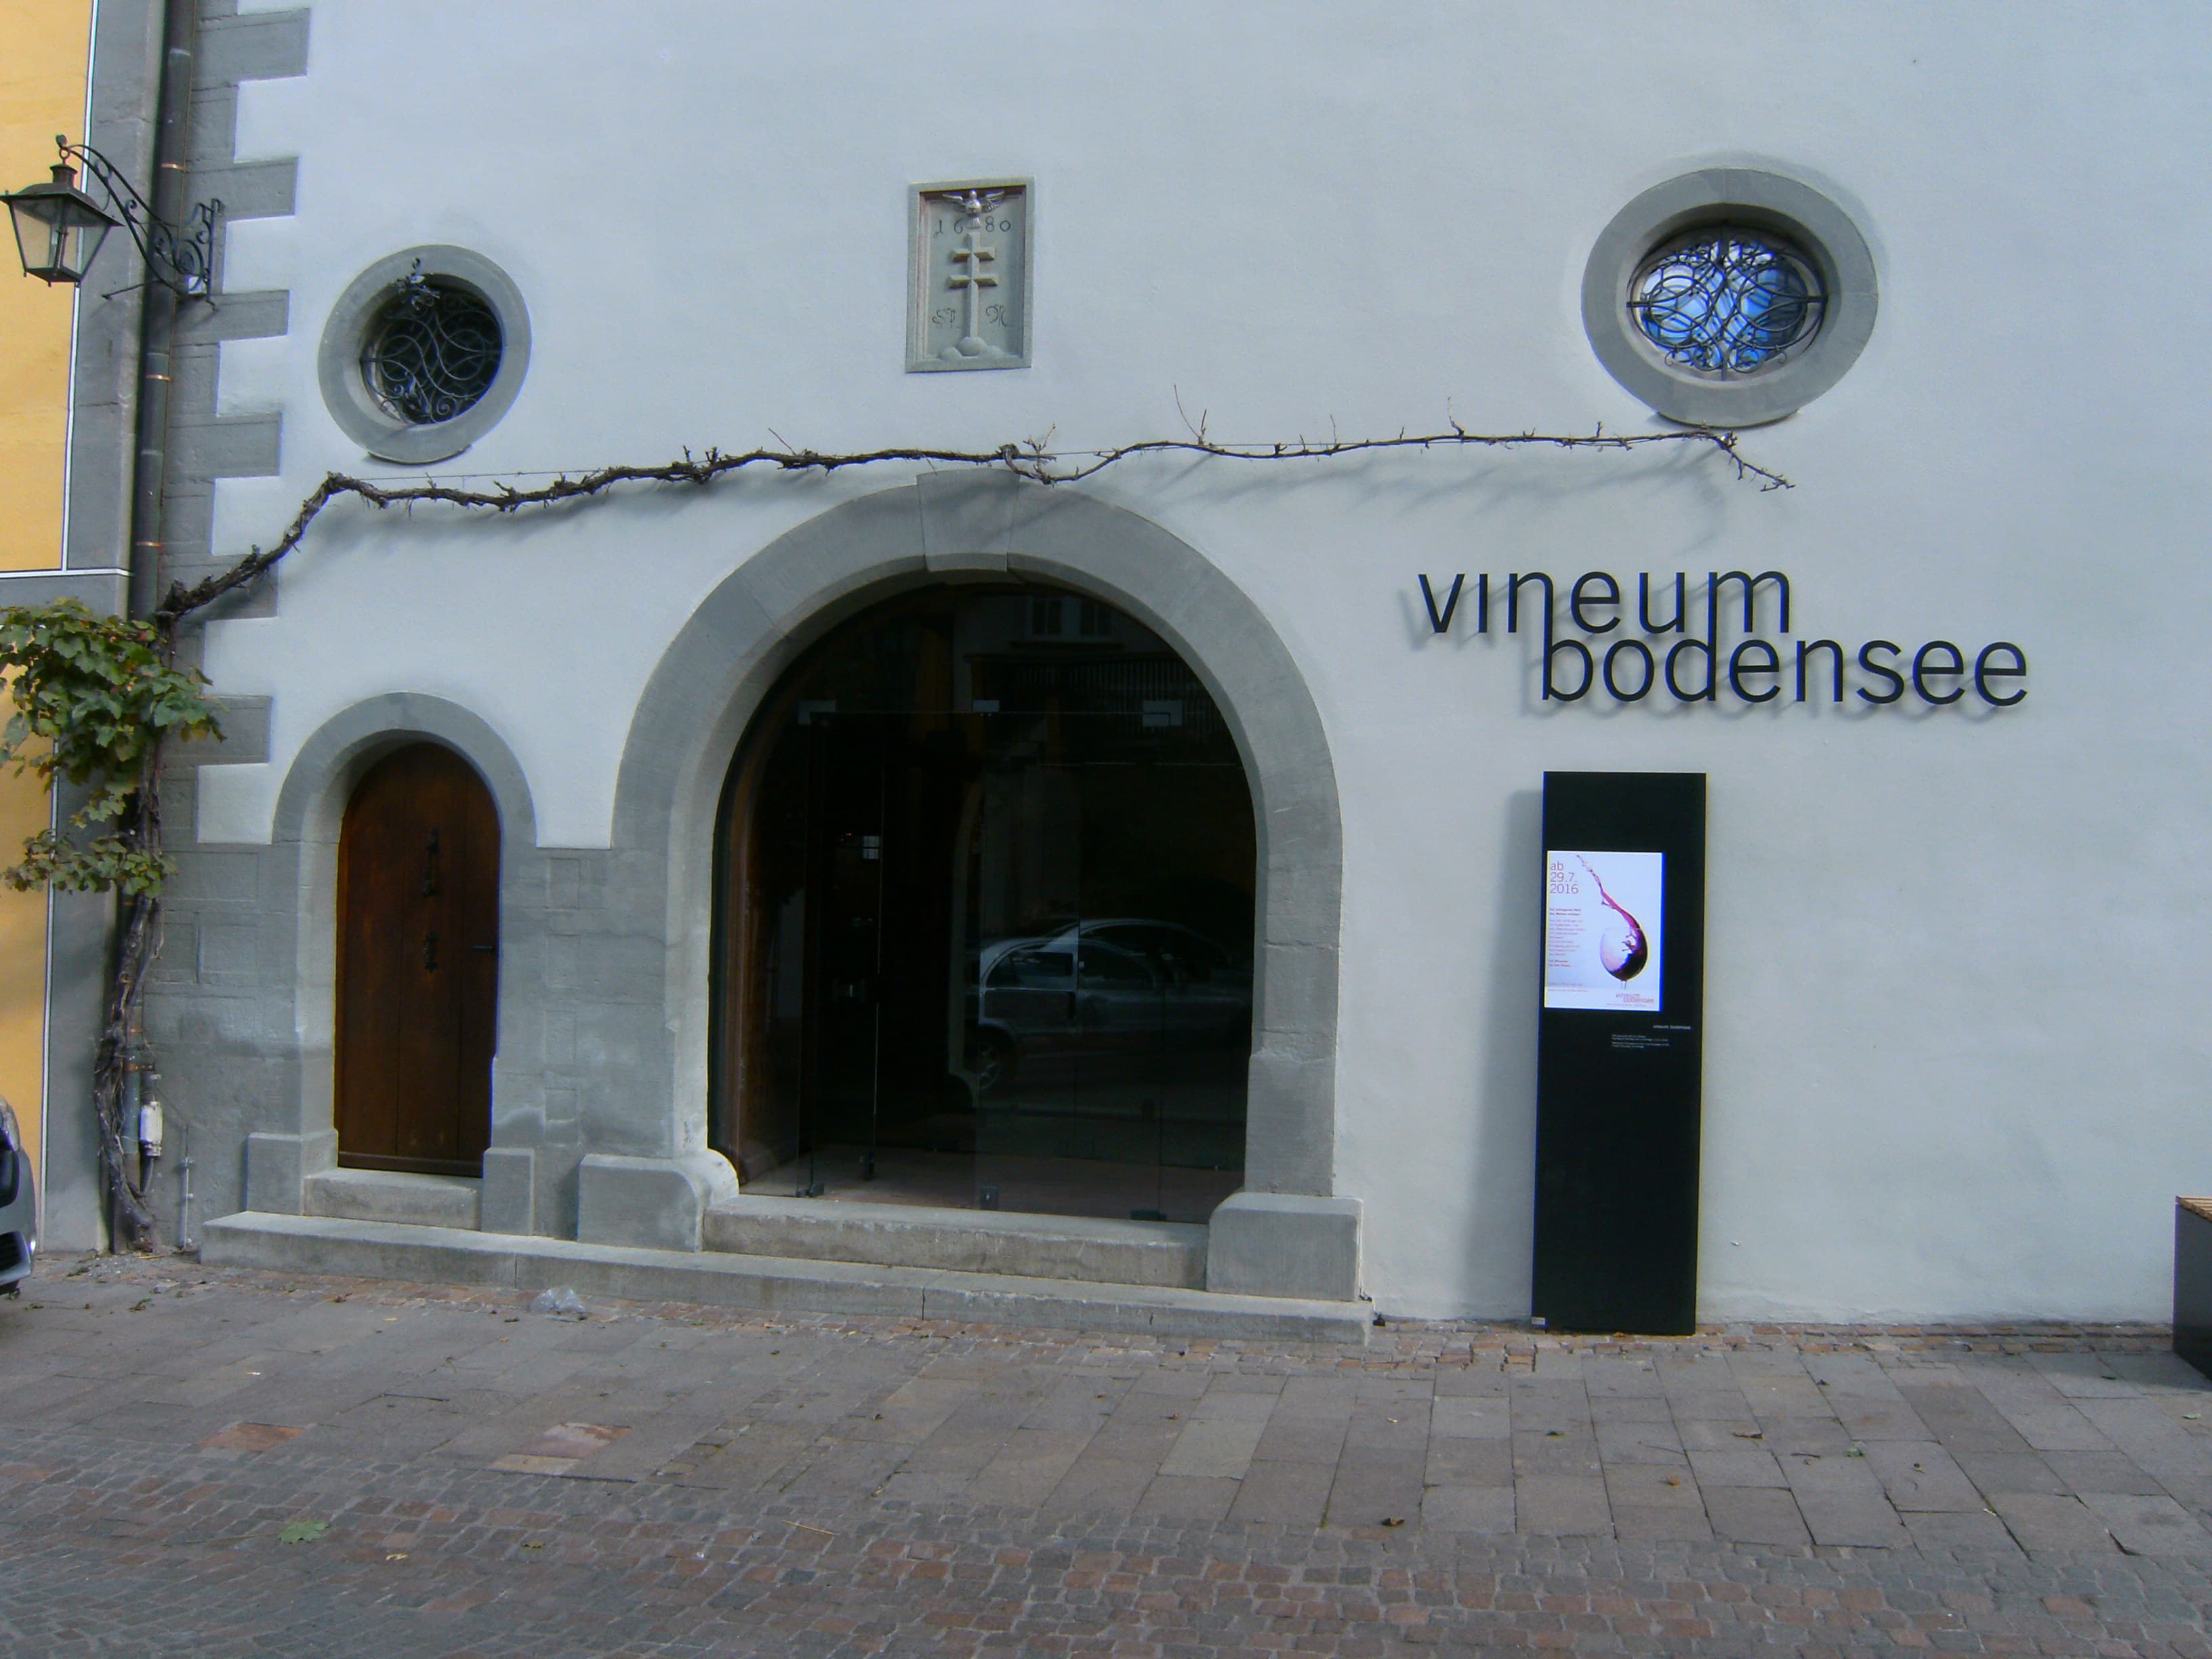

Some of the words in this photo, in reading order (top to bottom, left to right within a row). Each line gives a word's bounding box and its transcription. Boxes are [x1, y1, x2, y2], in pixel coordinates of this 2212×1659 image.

[1418, 571, 1790, 634] vineum
[1542, 620, 2028, 705] bodensee
[1550, 861, 1564, 871] ab
[1550, 872, 1578, 882] 29.7.
[1549, 883, 1578, 894] 2016
